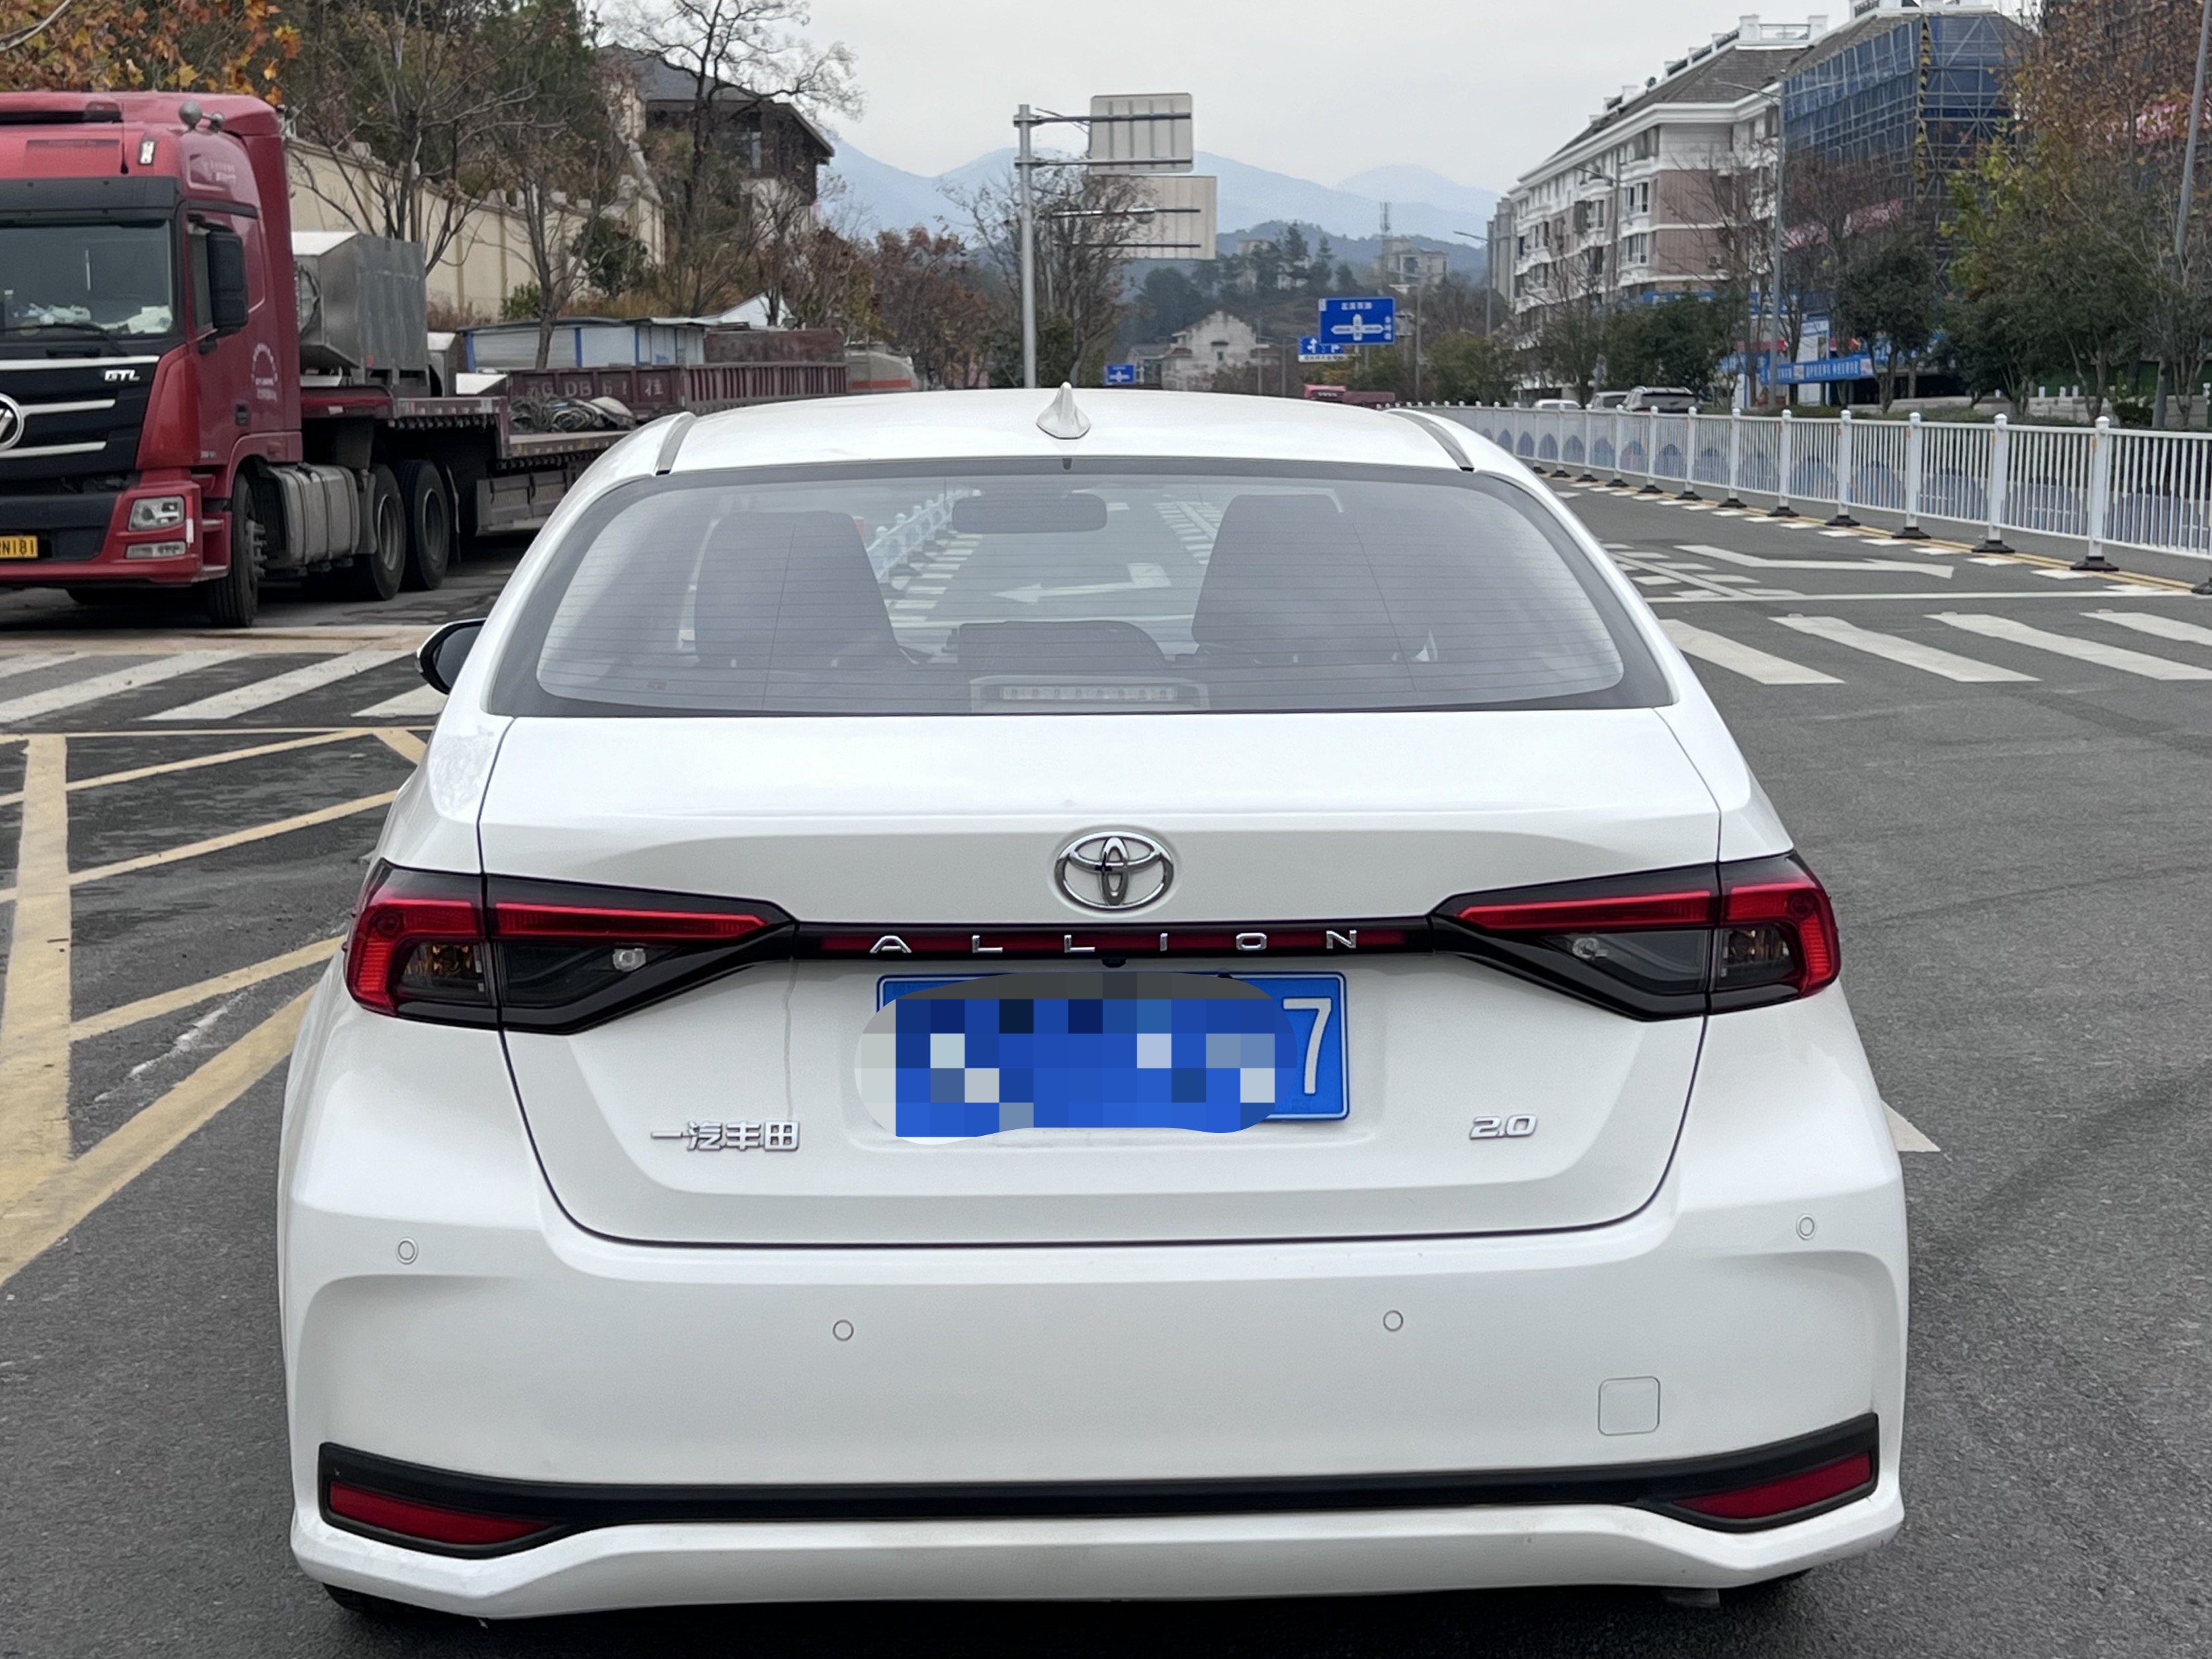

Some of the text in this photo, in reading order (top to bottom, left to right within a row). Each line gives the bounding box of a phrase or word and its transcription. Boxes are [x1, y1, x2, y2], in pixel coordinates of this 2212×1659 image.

[0, 538, 34, 556] N181
[869, 929, 1357, 954] ALLION
[651, 1121, 800, 1152] 一汽丰田
[1468, 1113, 1538, 1140] 2.0
